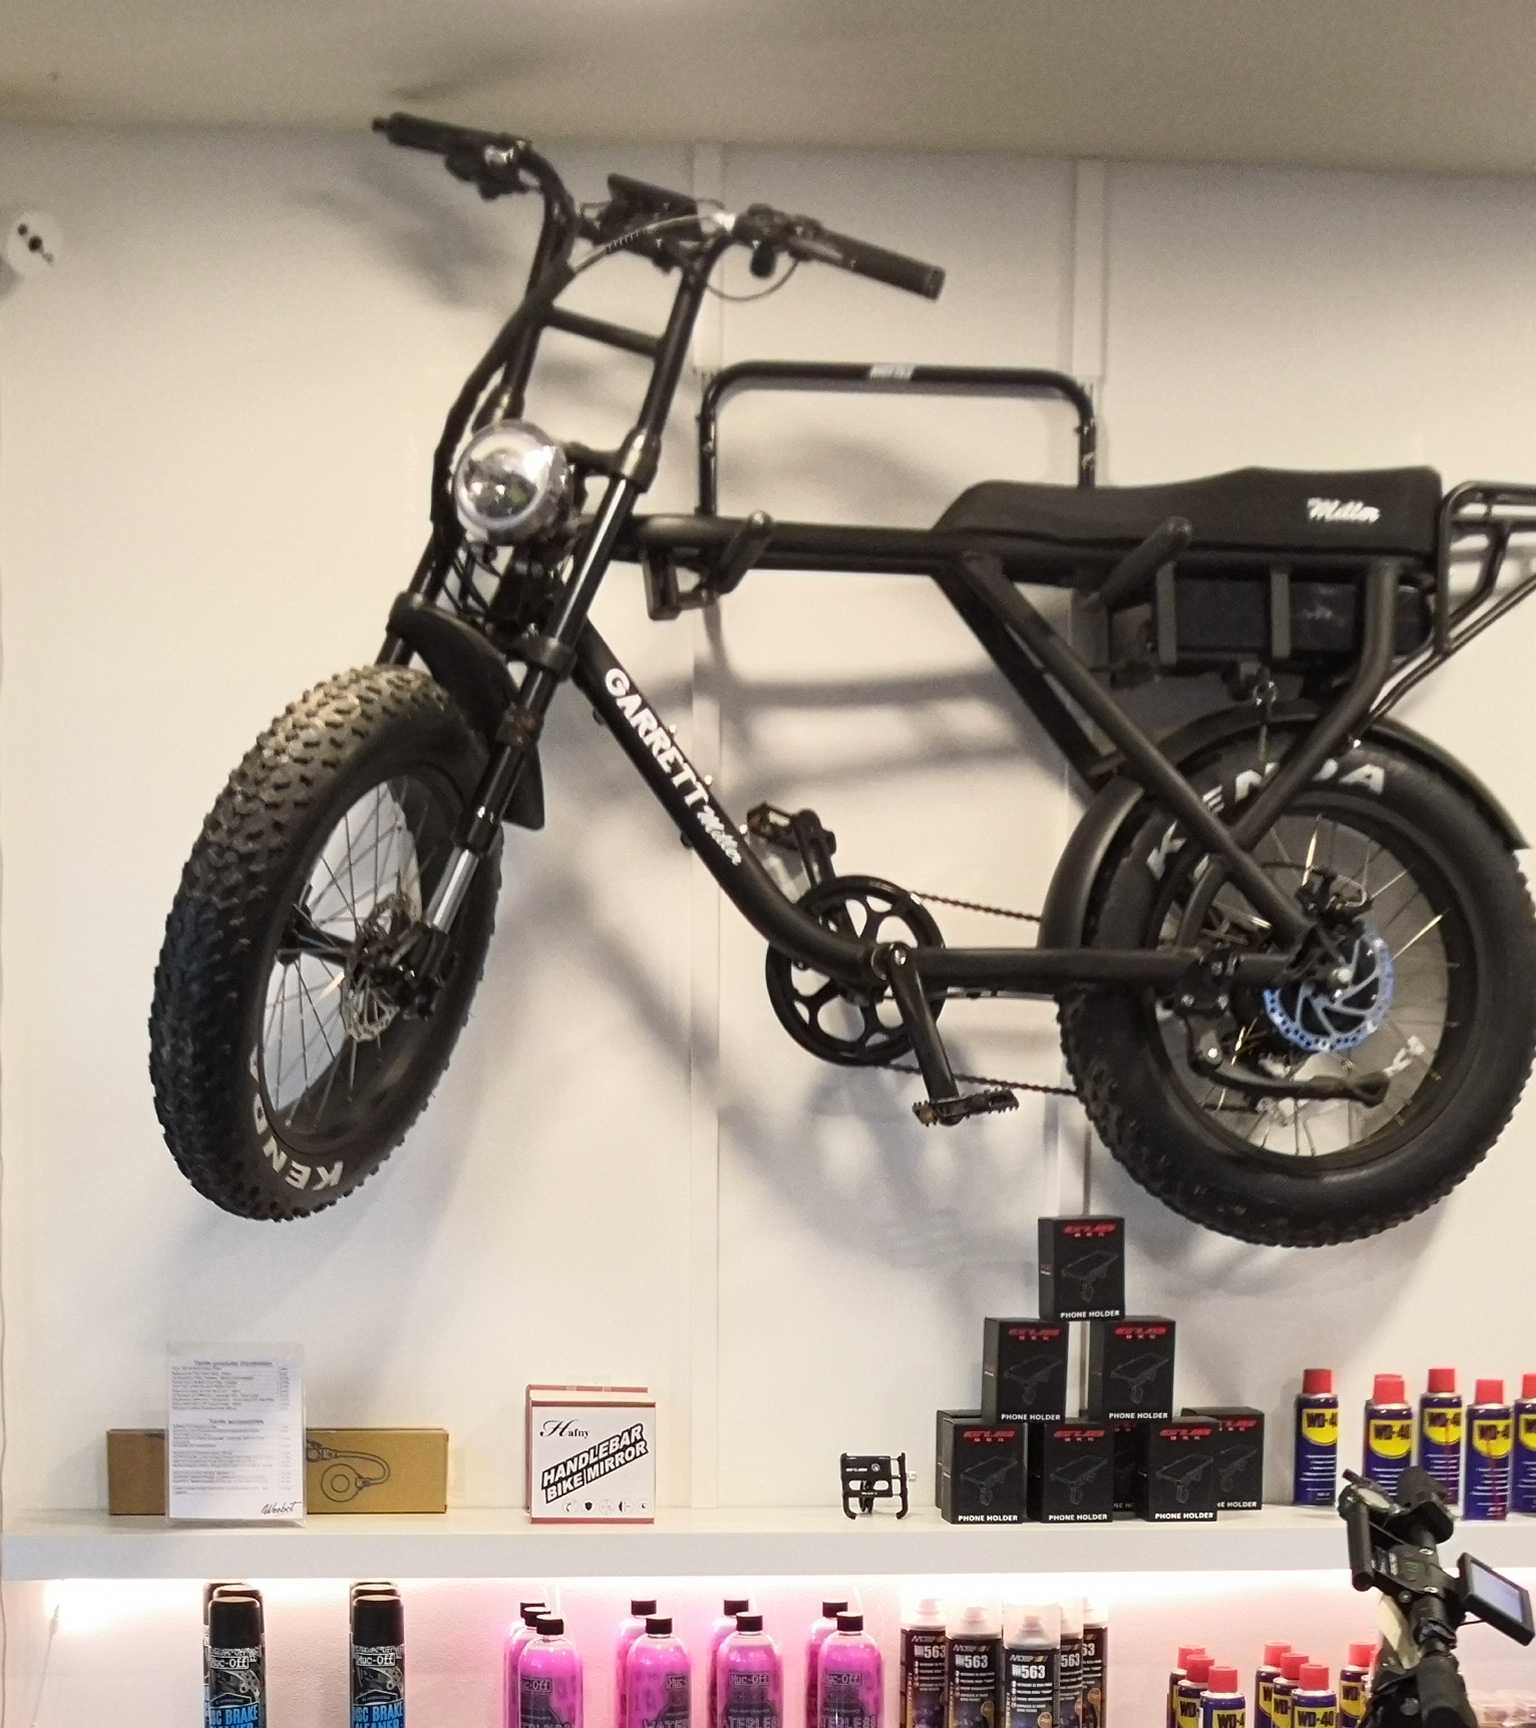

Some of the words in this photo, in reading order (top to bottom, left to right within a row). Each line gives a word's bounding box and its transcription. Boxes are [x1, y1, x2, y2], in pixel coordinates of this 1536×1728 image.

[605, 668, 709, 808] GARRETT
[1060, 1311, 1087, 1320] PHONE
[1089, 1309, 1120, 1318] HOLDER
[1001, 1413, 1027, 1421] PHONE
[1030, 1413, 1061, 1421] HOLDER
[1109, 1412, 1134, 1420] PHONE
[1137, 1411, 1168, 1420] HOLDER
[541, 1423, 644, 1489] HANDLEBAR
[545, 1470, 584, 1504] BIKE
[585, 1440, 649, 1484] MIRROR
[1227, 1500, 1257, 1509] HOLDER
[958, 1513, 984, 1522] PHONE
[986, 1513, 1019, 1522] HOLDER
[1048, 1513, 1074, 1521] PHONE
[1076, 1512, 1107, 1521] HOLDER
[1155, 1512, 1180, 1520] PHONE
[1182, 1511, 1213, 1520] HOLDER
[225, 1703, 258, 1723] BRAKE
[372, 1702, 403, 1721] BRAKE
[1297, 1710, 1335, 1728] WD-40
